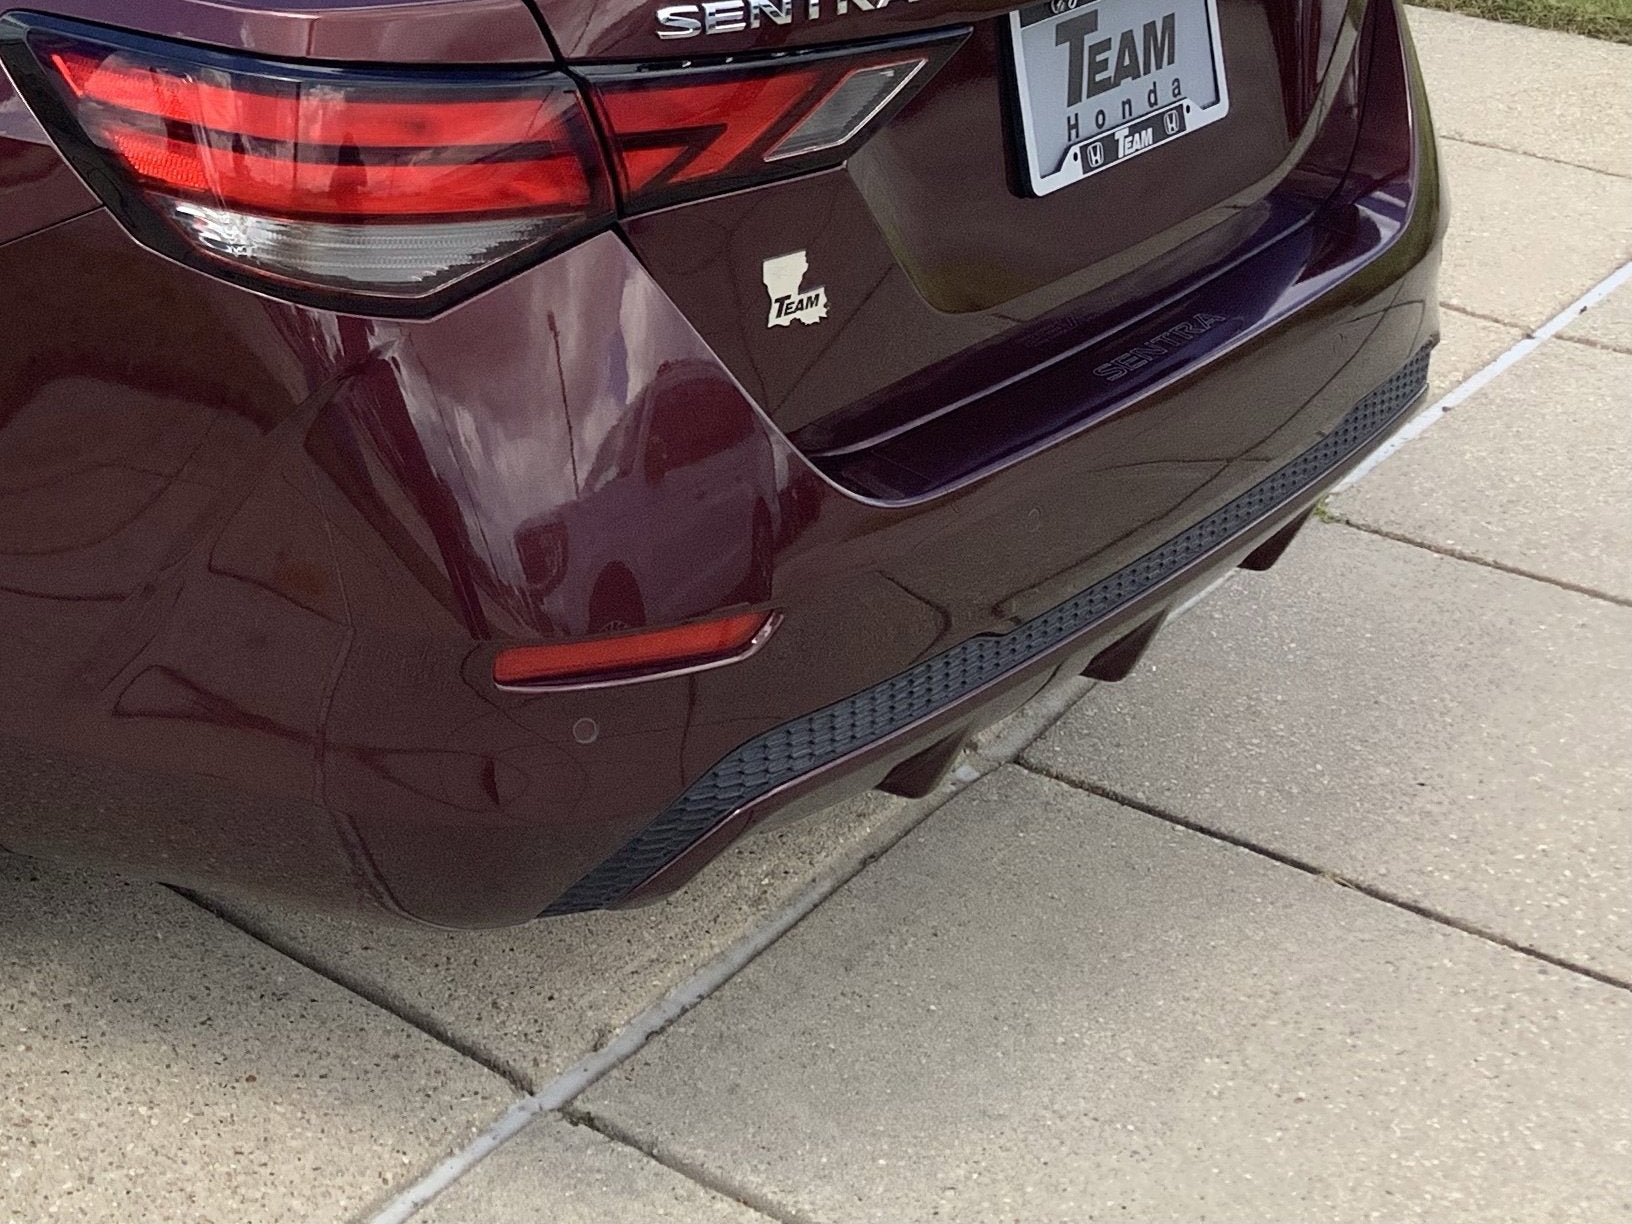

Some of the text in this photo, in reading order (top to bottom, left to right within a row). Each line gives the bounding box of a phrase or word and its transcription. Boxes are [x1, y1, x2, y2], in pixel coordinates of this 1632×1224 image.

[1055, 9, 1176, 108] TEAM
[1066, 77, 1182, 143] Honda
[1114, 127, 1154, 159] TEAM
[773, 294, 821, 319] TEAM
[1092, 311, 1227, 382] SENTRA
